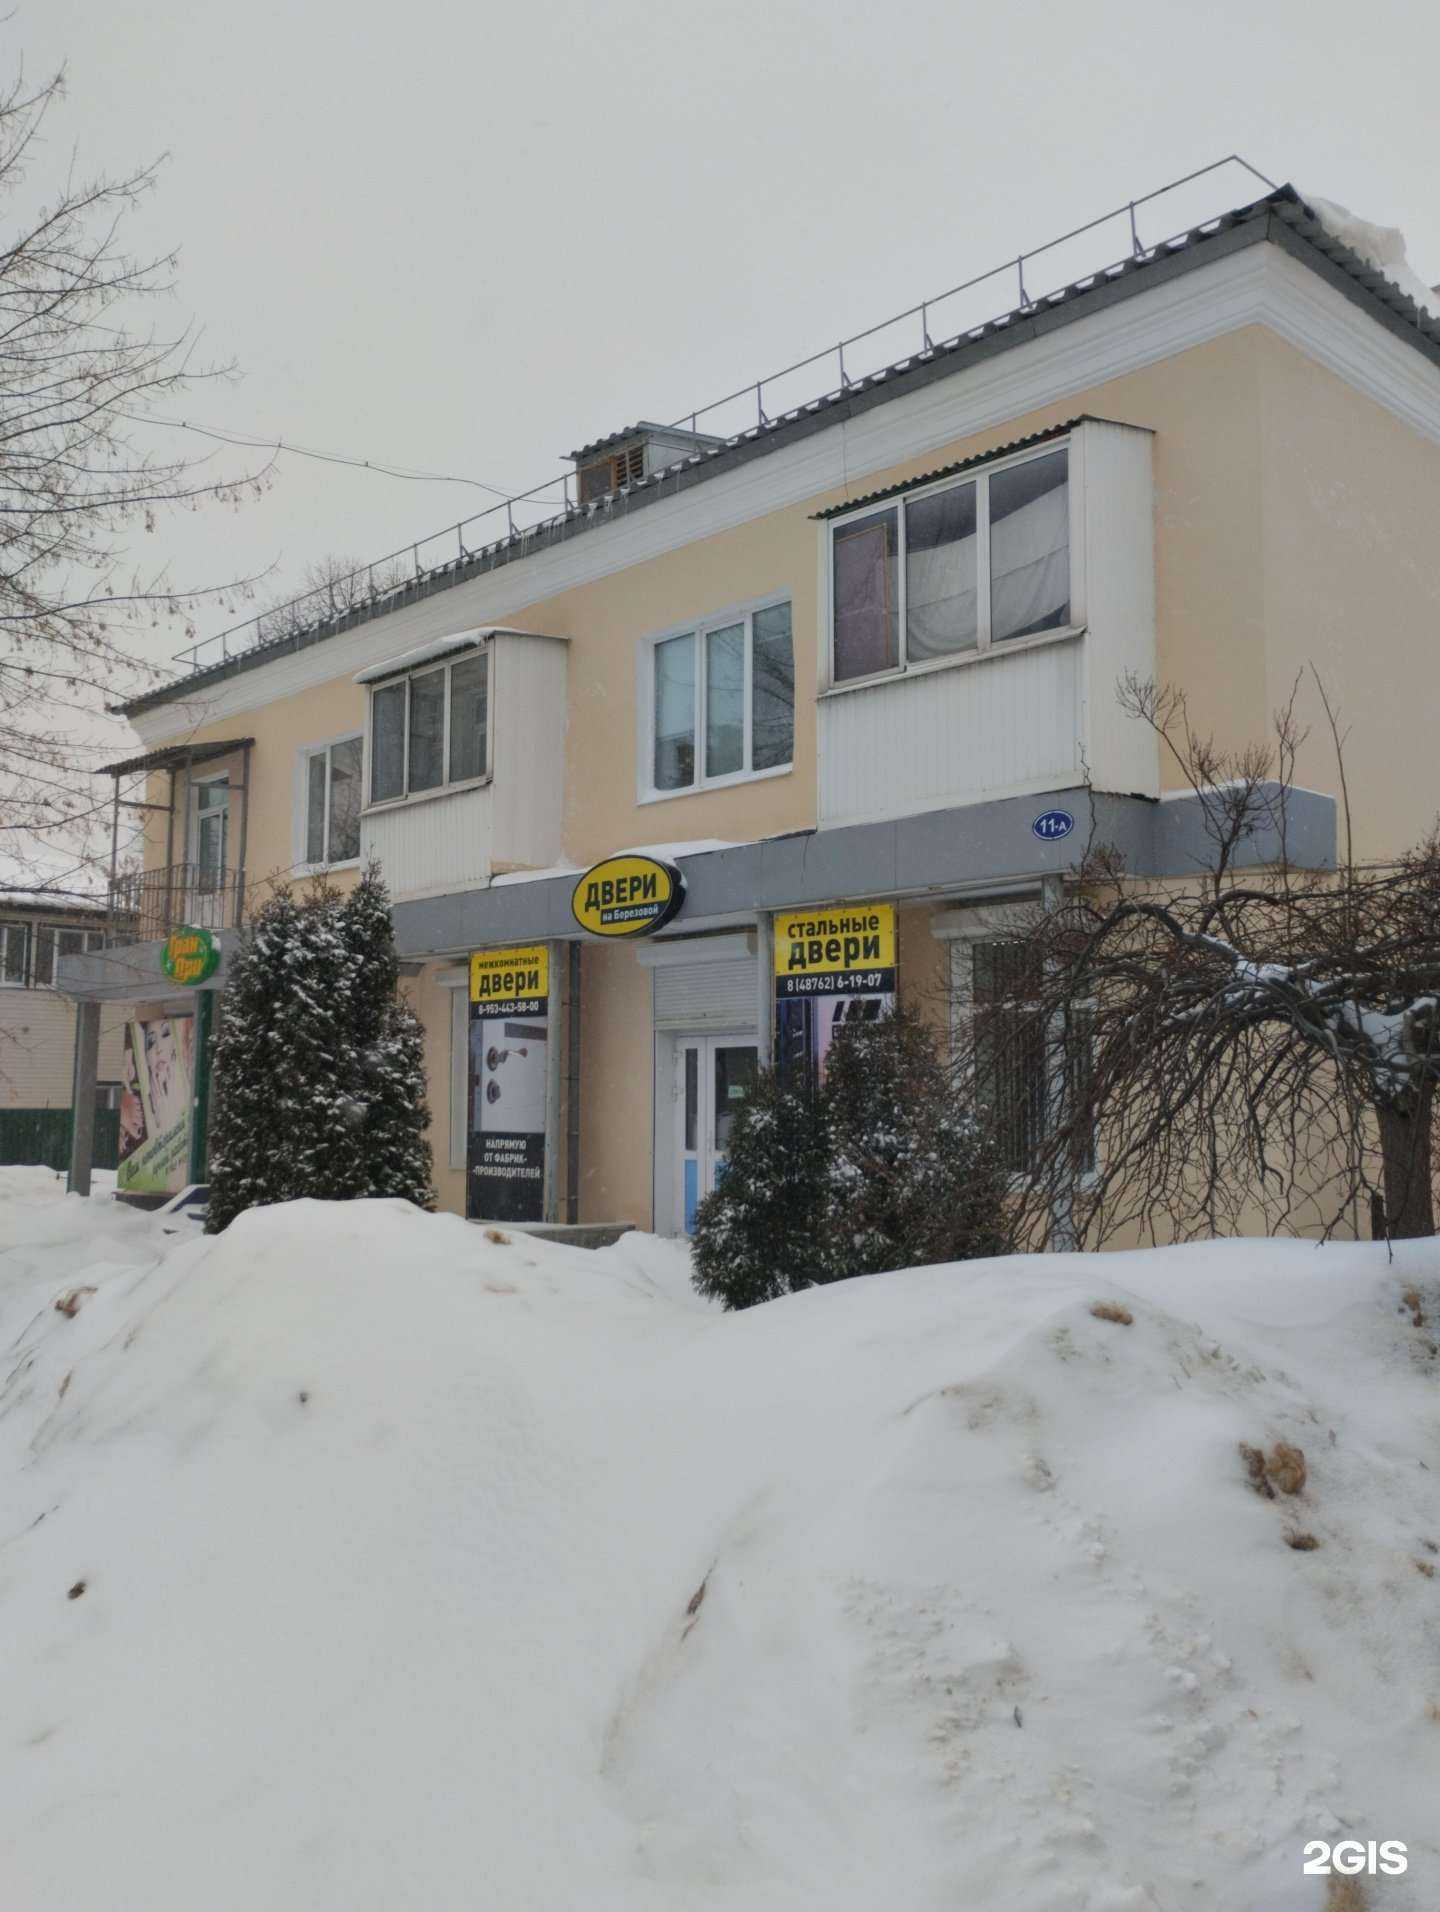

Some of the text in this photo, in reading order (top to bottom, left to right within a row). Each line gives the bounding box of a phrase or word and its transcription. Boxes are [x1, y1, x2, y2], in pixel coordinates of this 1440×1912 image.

[1040, 818, 1067, 833] 11-А
[585, 873, 657, 912] ДВЕРИ
[602, 903, 658, 921] на Березовой
[788, 915, 880, 938] стальные
[788, 935, 880, 970] двери
[479, 970, 540, 997] двери
[787, 973, 882, 992] 8 (48762) 6-19-07
[486, 1139, 527, 1150] НАПРЯМУЮ
[484, 1152, 493, 1162] ОТ
